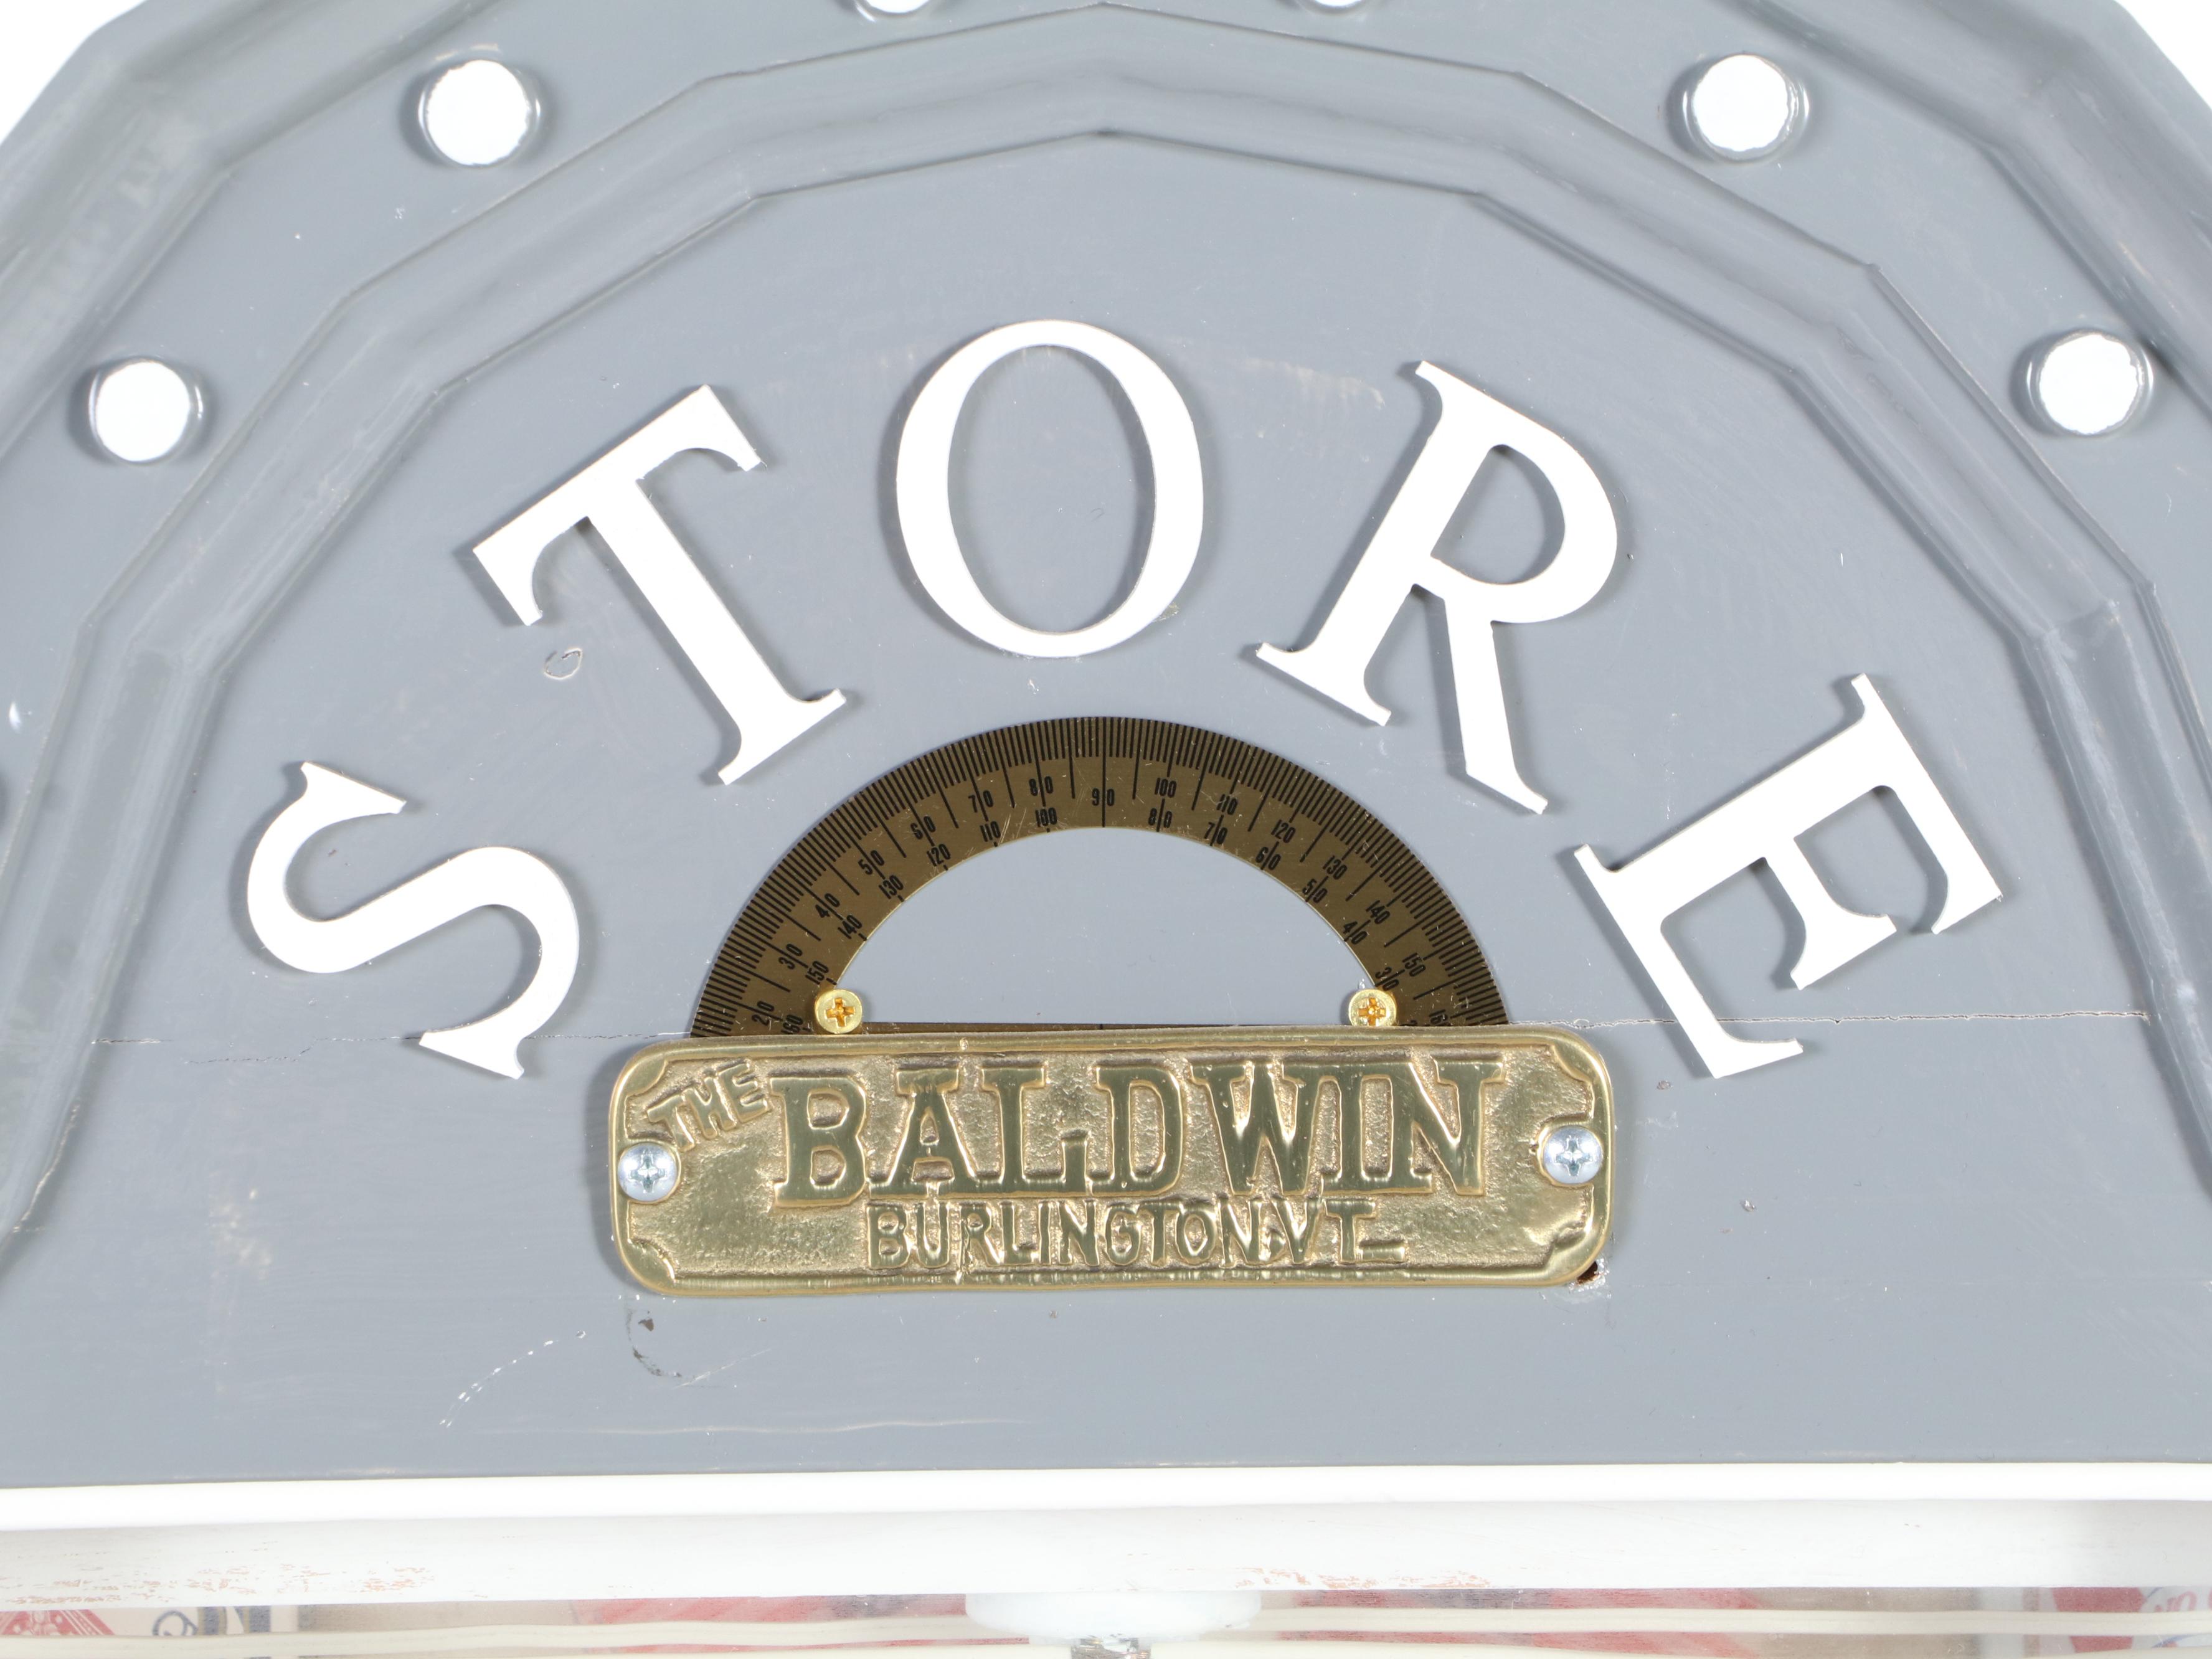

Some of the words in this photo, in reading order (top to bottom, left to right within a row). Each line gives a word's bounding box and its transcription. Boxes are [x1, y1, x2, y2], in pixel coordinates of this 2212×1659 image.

[245, 319, 2004, 1081] STORE
[1029, 777, 1054, 796] 80
[1092, 788, 1115, 806] 90
[1154, 777, 1176, 797] 100
[968, 793, 993, 812] 70
[1216, 795, 1236, 816] 110
[911, 816, 937, 839] 60
[1036, 808, 1057, 826] 100
[1148, 809, 1172, 828] 80
[981, 824, 999, 842] 110
[1204, 822, 1226, 844] 70
[1272, 820, 1295, 842] 120
[858, 849, 884, 875] 50
[926, 844, 951, 867] 120
[1256, 847, 1279, 869] 60
[1322, 858, 1348, 879] 130
[879, 875, 903, 899] 130
[1302, 879, 1325, 902] 50
[815, 892, 841, 919] 40
[1366, 900, 1390, 924] 140
[838, 914, 863, 938] 140
[1343, 920, 1367, 944] 40
[778, 943, 803, 970] 30
[1402, 952, 1425, 976] 150
[806, 961, 828, 986] 150
[1376, 967, 1399, 990] 30
[752, 1001, 775, 1025] 20
[646, 1059, 768, 1152] THE
[770, 1056, 1506, 1206] BALDWIN
